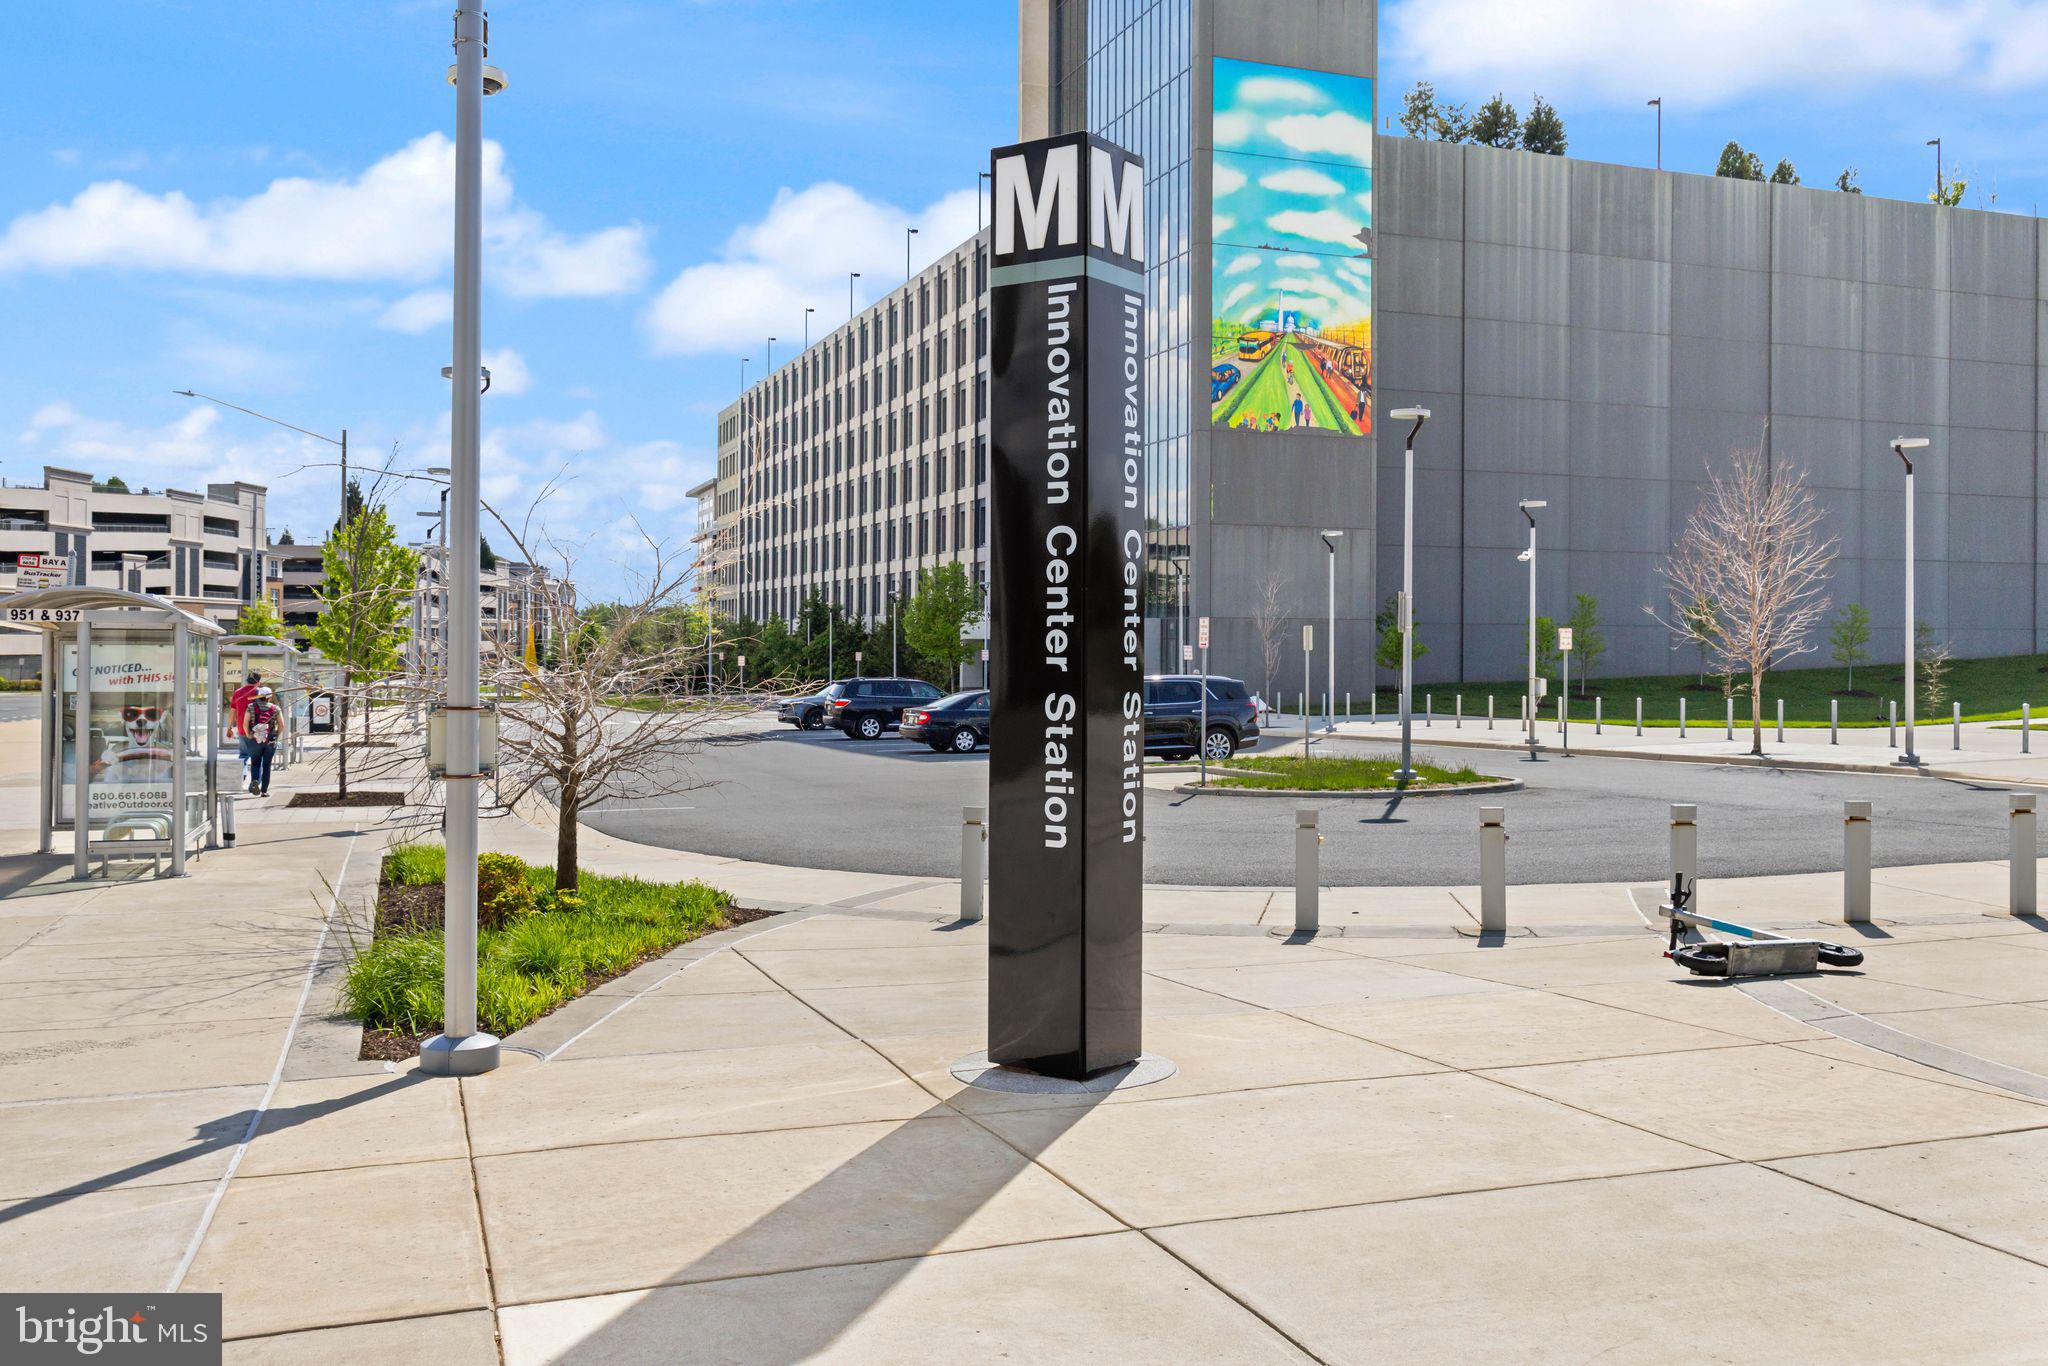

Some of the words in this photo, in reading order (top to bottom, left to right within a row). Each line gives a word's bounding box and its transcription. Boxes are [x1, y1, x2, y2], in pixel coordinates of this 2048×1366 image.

[995, 144, 1078, 256] M
[1090, 145, 1144, 263] M
[1047, 282, 1078, 505] Innovation
[1123, 293, 1142, 509] Innovation
[10, 609, 34, 620] 951
[40, 609, 50, 621] &
[55, 610, 80, 621] 937
[23, 570, 62, 578] BusTracker
[42, 558, 58, 566] BAY
[1045, 524, 1077, 672] Center
[1122, 528, 1142, 672] Center
[109, 675, 134, 685] with
[136, 673, 161, 683] THIS
[92, 791, 168, 801] 800.661.6088
[1044, 692, 1076, 849] Station
[1122, 691, 1141, 843] Station
